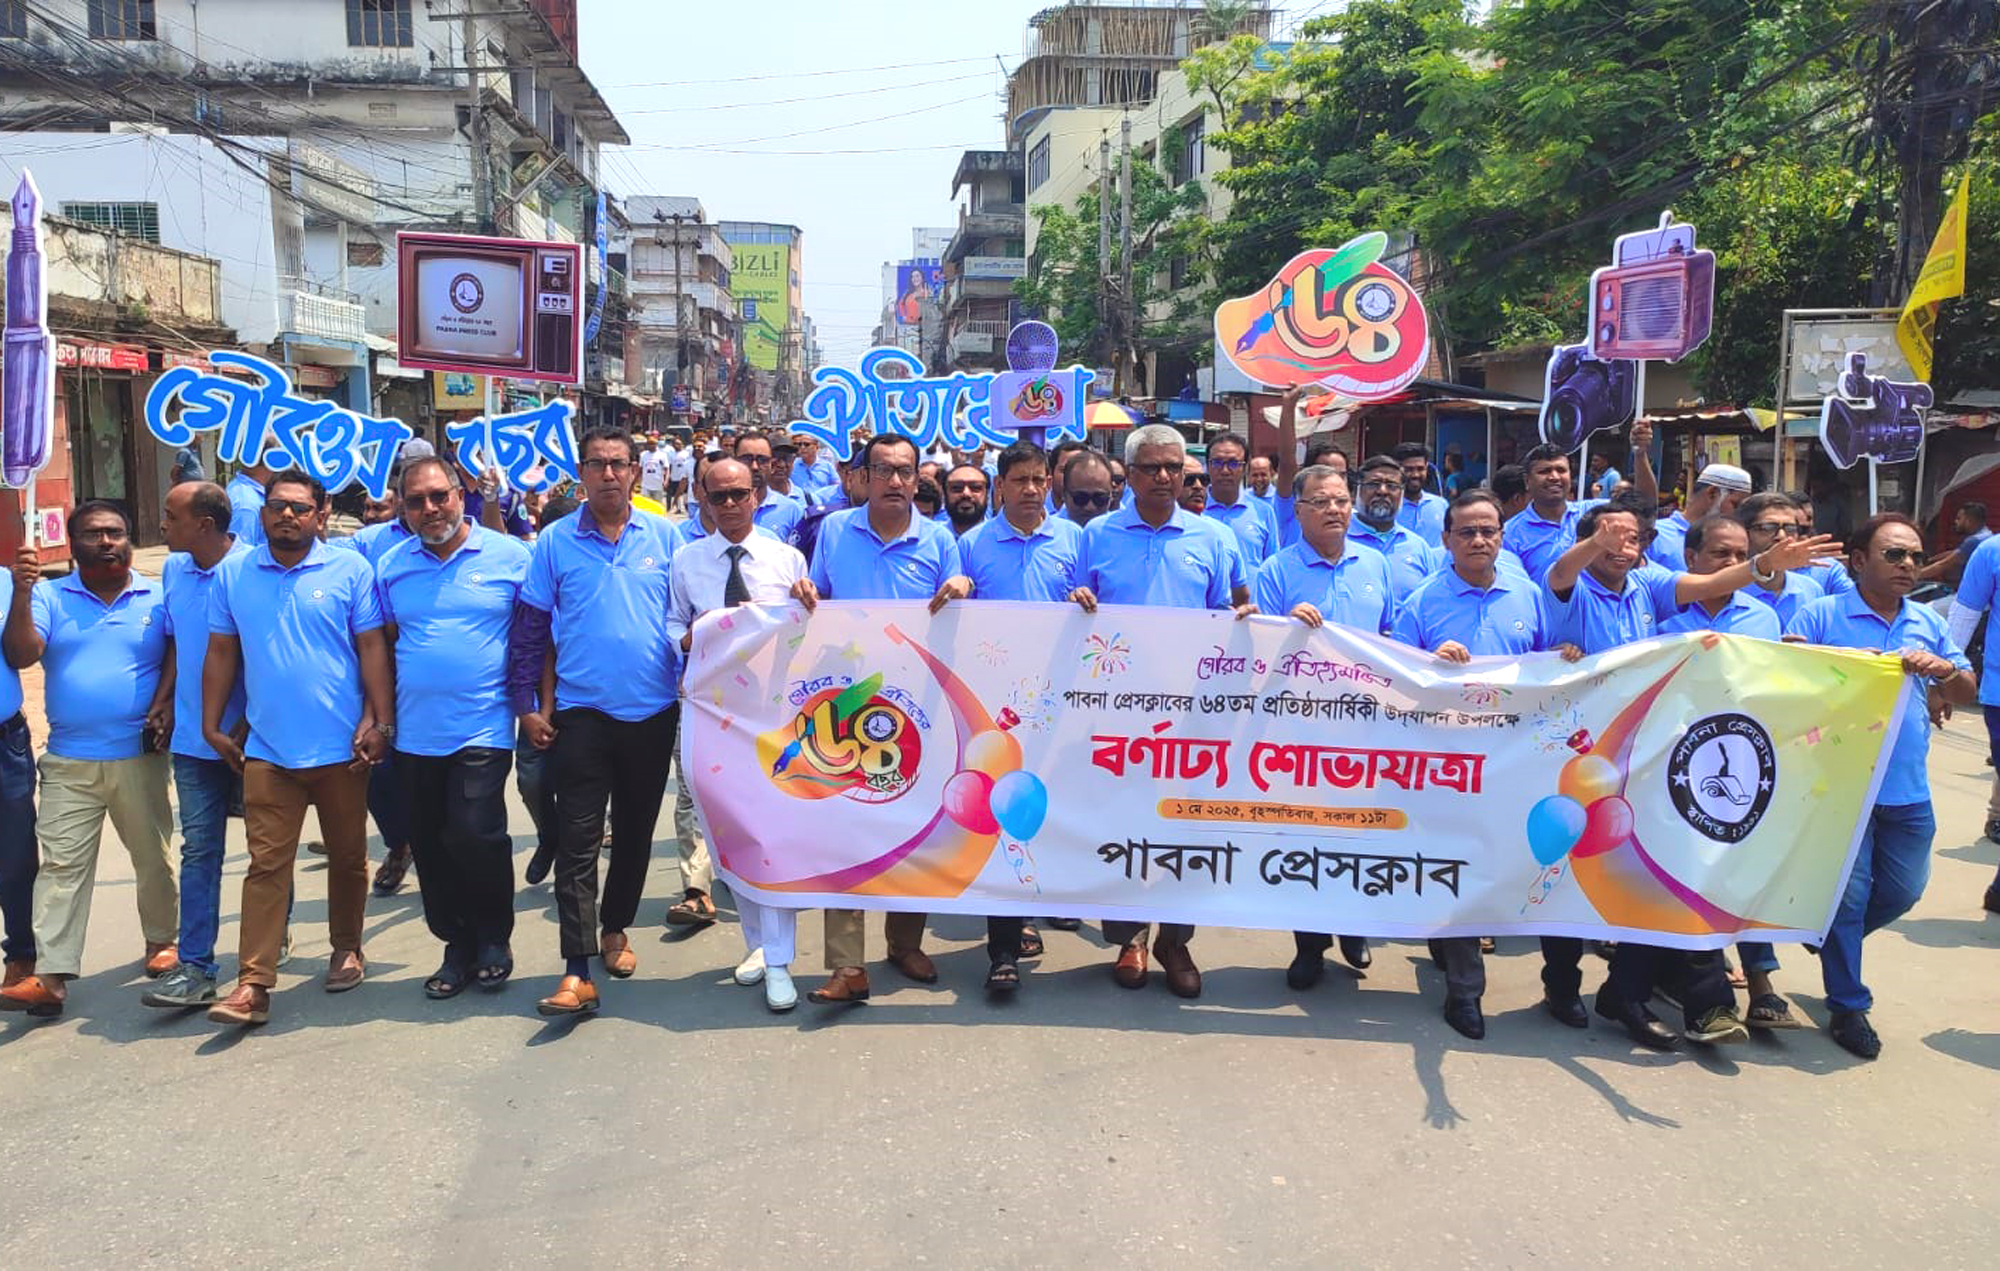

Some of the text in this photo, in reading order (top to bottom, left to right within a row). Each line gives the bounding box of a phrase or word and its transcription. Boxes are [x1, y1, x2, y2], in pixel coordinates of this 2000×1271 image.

[1197, 646, 1246, 680] গৌরব
[1252, 658, 1267, 675] ও
[1063, 689, 1108, 710] পাবনা
[1114, 691, 1193, 713] প্রেসক্লাবের
[1200, 693, 1258, 715] ৬৪তম
[1262, 690, 1379, 722] প্রতিষ্ঠাবার্ষিকী
[1456, 711, 1521, 729] উপলক্ষে
[795, 699, 907, 777] ৬৪
[1091, 721, 1487, 794] বর্ণাঢ্য শোভাযাত্রা
[1676, 722, 1718, 765] পাবনা
[1176, 803, 1184, 814] ১
[1188, 803, 1202, 814] মে
[1206, 804, 1245, 818] ২০২৫,
[1323, 810, 1356, 823] সকাল
[1360, 811, 1388, 825] ১১টা
[1097, 837, 1470, 898] পাবনা প্রেসক্লাব
